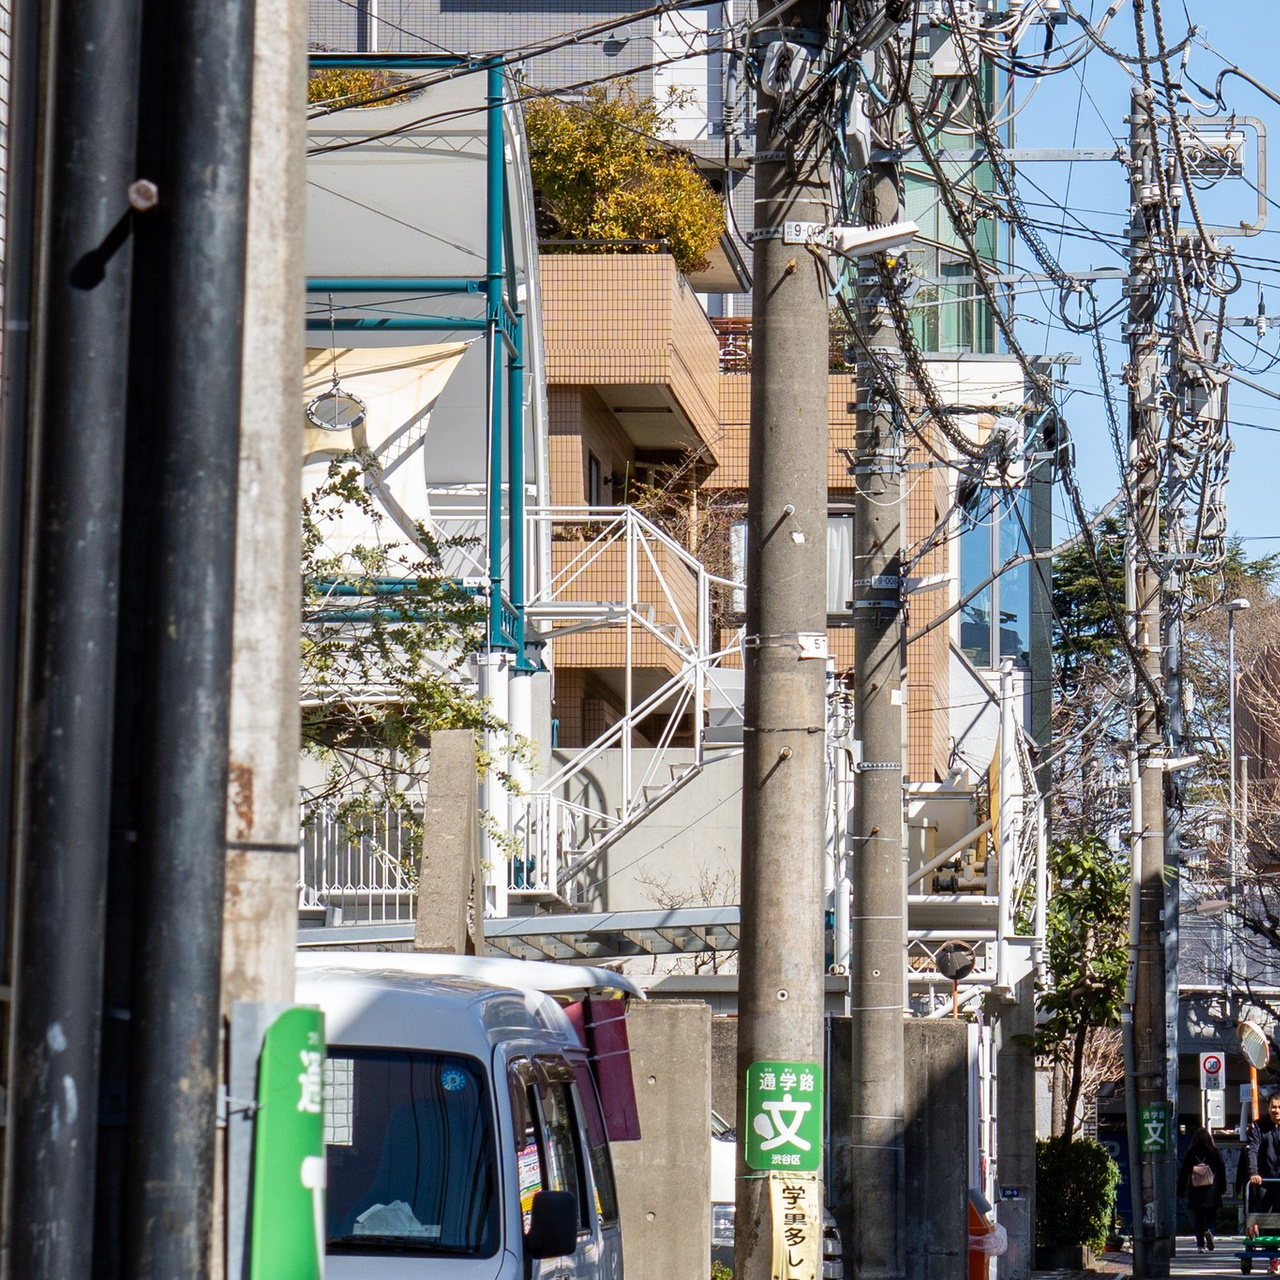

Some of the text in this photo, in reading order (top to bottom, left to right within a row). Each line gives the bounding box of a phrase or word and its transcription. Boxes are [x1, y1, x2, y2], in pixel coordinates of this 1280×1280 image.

[759, 1073, 814, 1092] 通学路
[760, 1093, 812, 1151] 文
[1144, 1120, 1164, 1145] 文
[771, 1153, 801, 1166] 渋谷区
